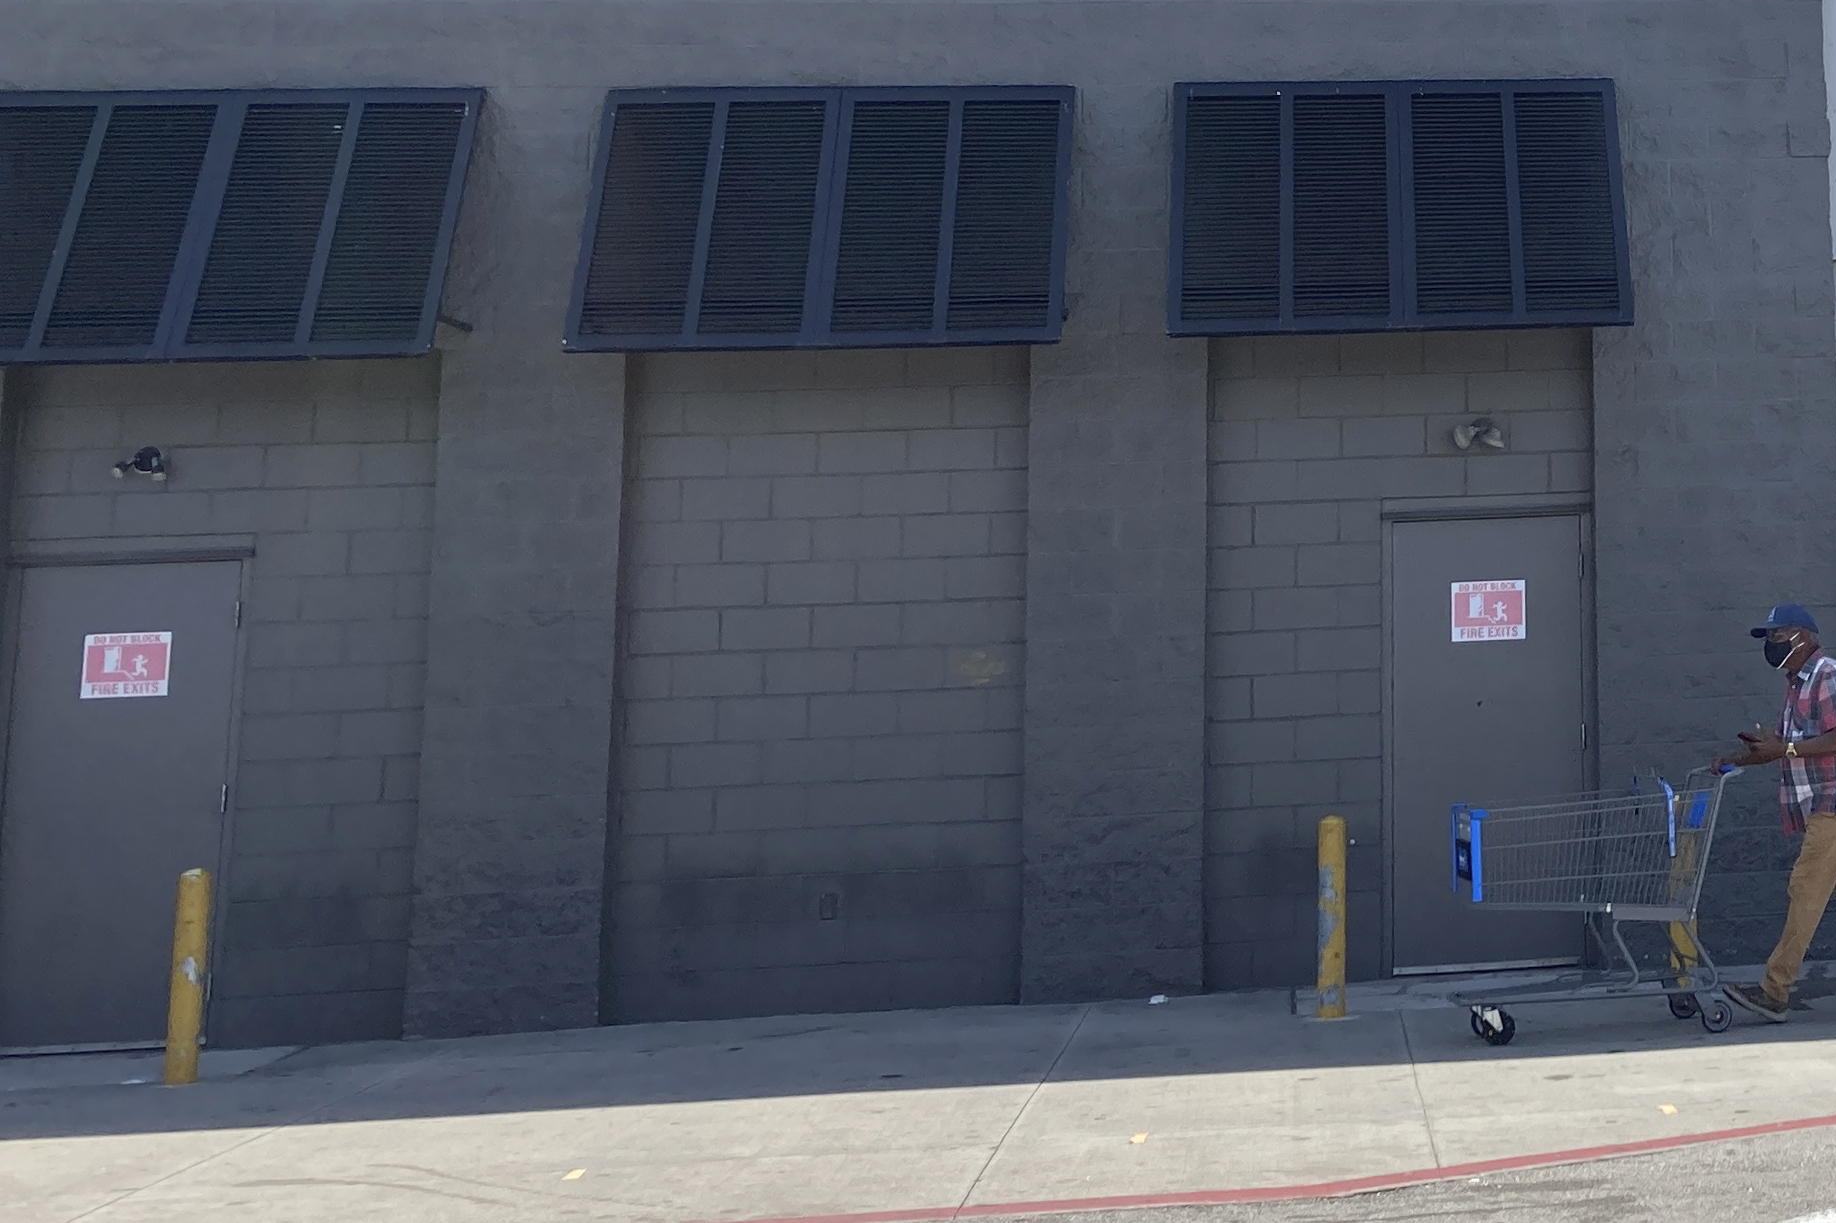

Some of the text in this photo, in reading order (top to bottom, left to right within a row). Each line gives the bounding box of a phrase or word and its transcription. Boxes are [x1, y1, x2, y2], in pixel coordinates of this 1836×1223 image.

[1459, 582, 1517, 592] DO NOT BLOCK
[1460, 626, 1518, 639] FIRE EXITS
[91, 682, 159, 696] FIRE EXITS
